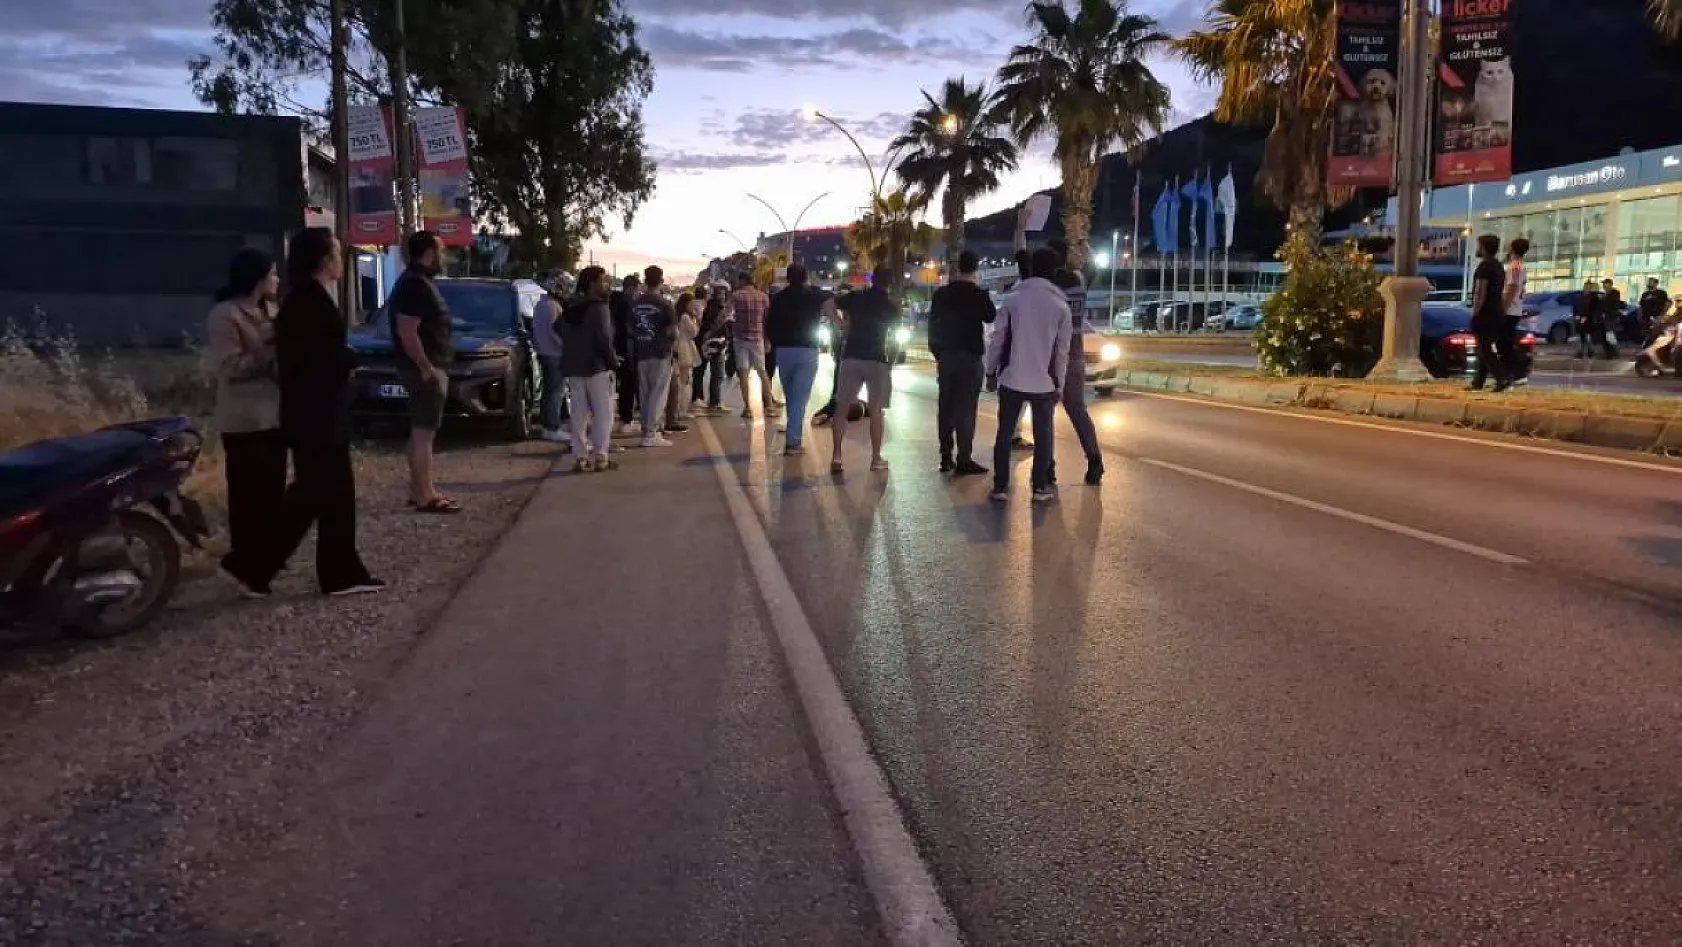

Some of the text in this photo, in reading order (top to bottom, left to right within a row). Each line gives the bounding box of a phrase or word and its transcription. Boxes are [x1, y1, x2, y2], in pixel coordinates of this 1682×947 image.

[349, 133, 382, 147] 750 TL
[427, 135, 458, 149] 750 TL
[1601, 165, 1626, 183] Oto
